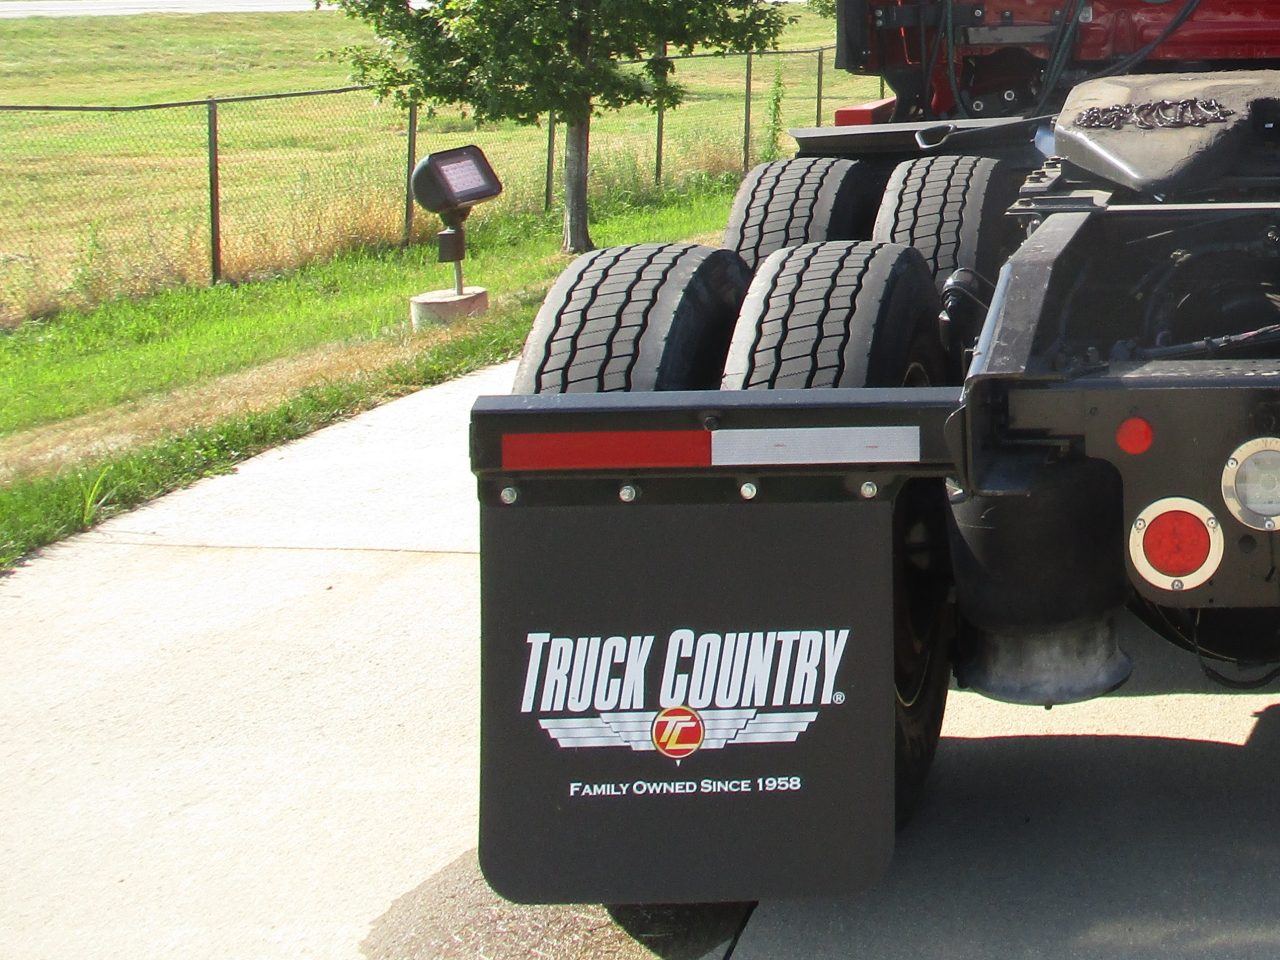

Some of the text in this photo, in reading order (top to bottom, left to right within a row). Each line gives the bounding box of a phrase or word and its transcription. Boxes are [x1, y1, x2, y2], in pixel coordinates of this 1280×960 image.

[521, 632, 655, 713] TRUCK
[569, 776, 802, 797] FAMILY OWNED SINCE 1958
